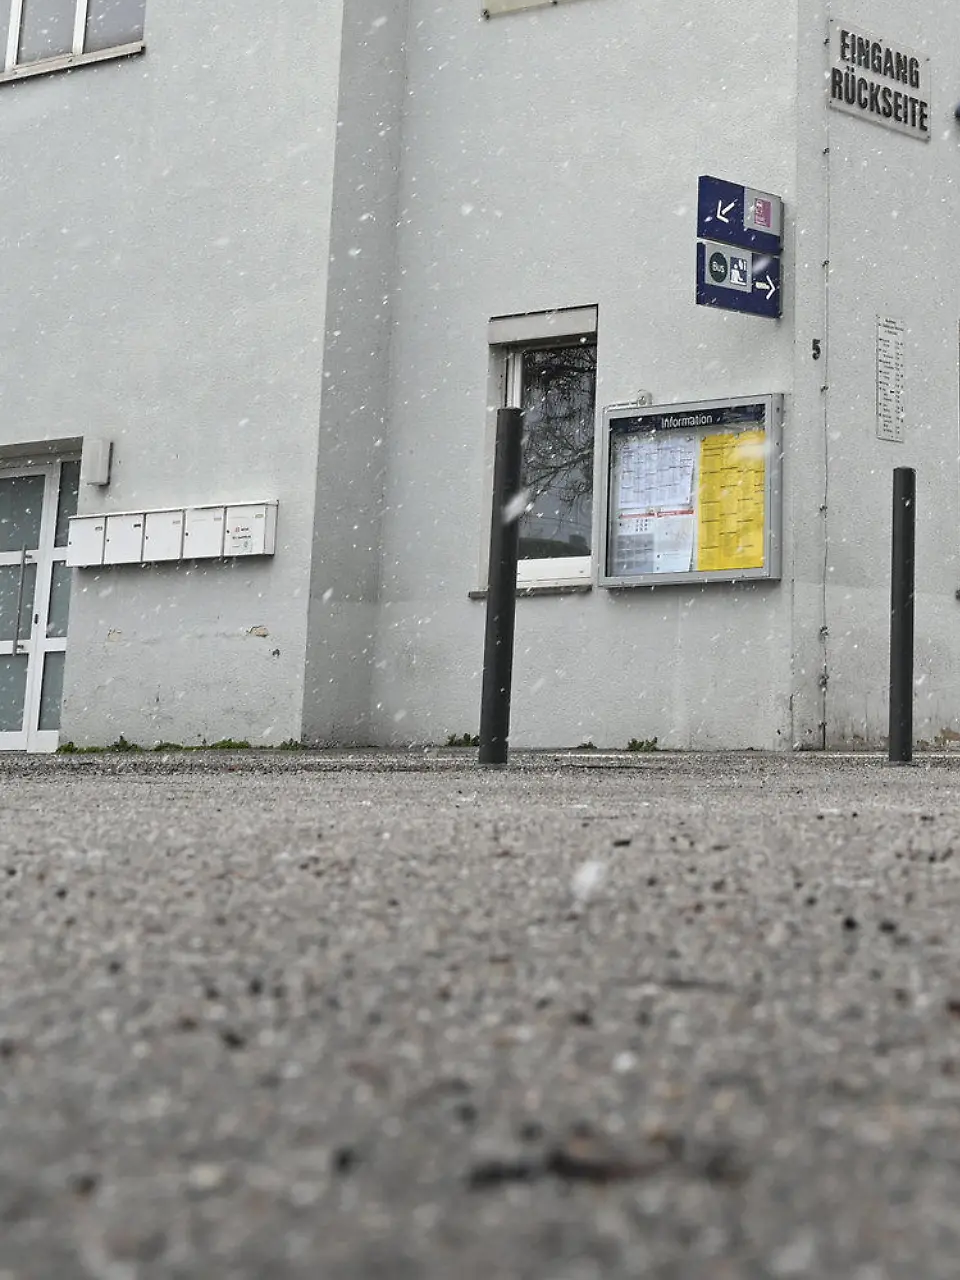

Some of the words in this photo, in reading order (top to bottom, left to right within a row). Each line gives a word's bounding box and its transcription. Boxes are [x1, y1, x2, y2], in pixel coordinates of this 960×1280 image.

[841, 30, 919, 89] EINGANG
[831, 65, 928, 131] RÜCKSEITE
[712, 261, 725, 273] Bus
[812, 338, 821, 361] 5
[661, 414, 714, 429] Information
